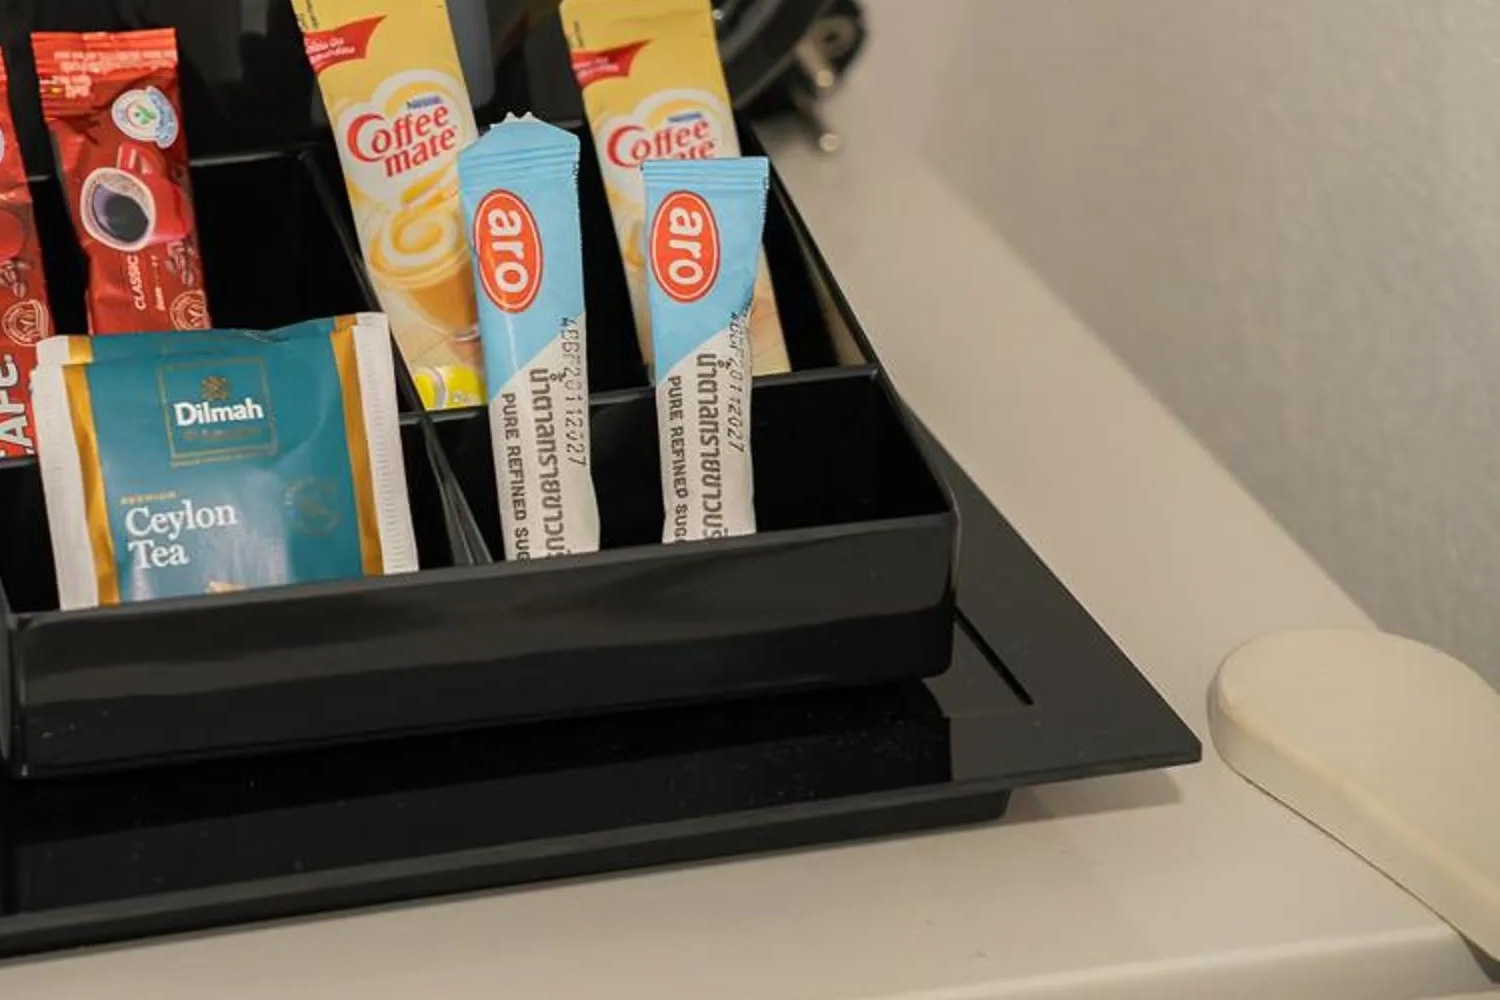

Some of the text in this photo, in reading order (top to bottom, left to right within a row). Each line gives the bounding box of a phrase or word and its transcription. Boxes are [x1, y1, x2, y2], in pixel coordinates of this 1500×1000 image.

[346, 105, 449, 163] Coffee
[384, 127, 455, 178] mate
[606, 120, 709, 169] Coffee
[487, 207, 530, 294] aro
[667, 206, 704, 286] aro
[126, 254, 148, 312] CLASSIC
[173, 397, 264, 428] Dilmah
[501, 392, 520, 439] PURE
[667, 375, 684, 421] PURE
[506, 444, 527, 521] REFINED
[669, 424, 689, 499] REFINED
[125, 498, 239, 541] Ceylon
[127, 539, 191, 569] Tea
